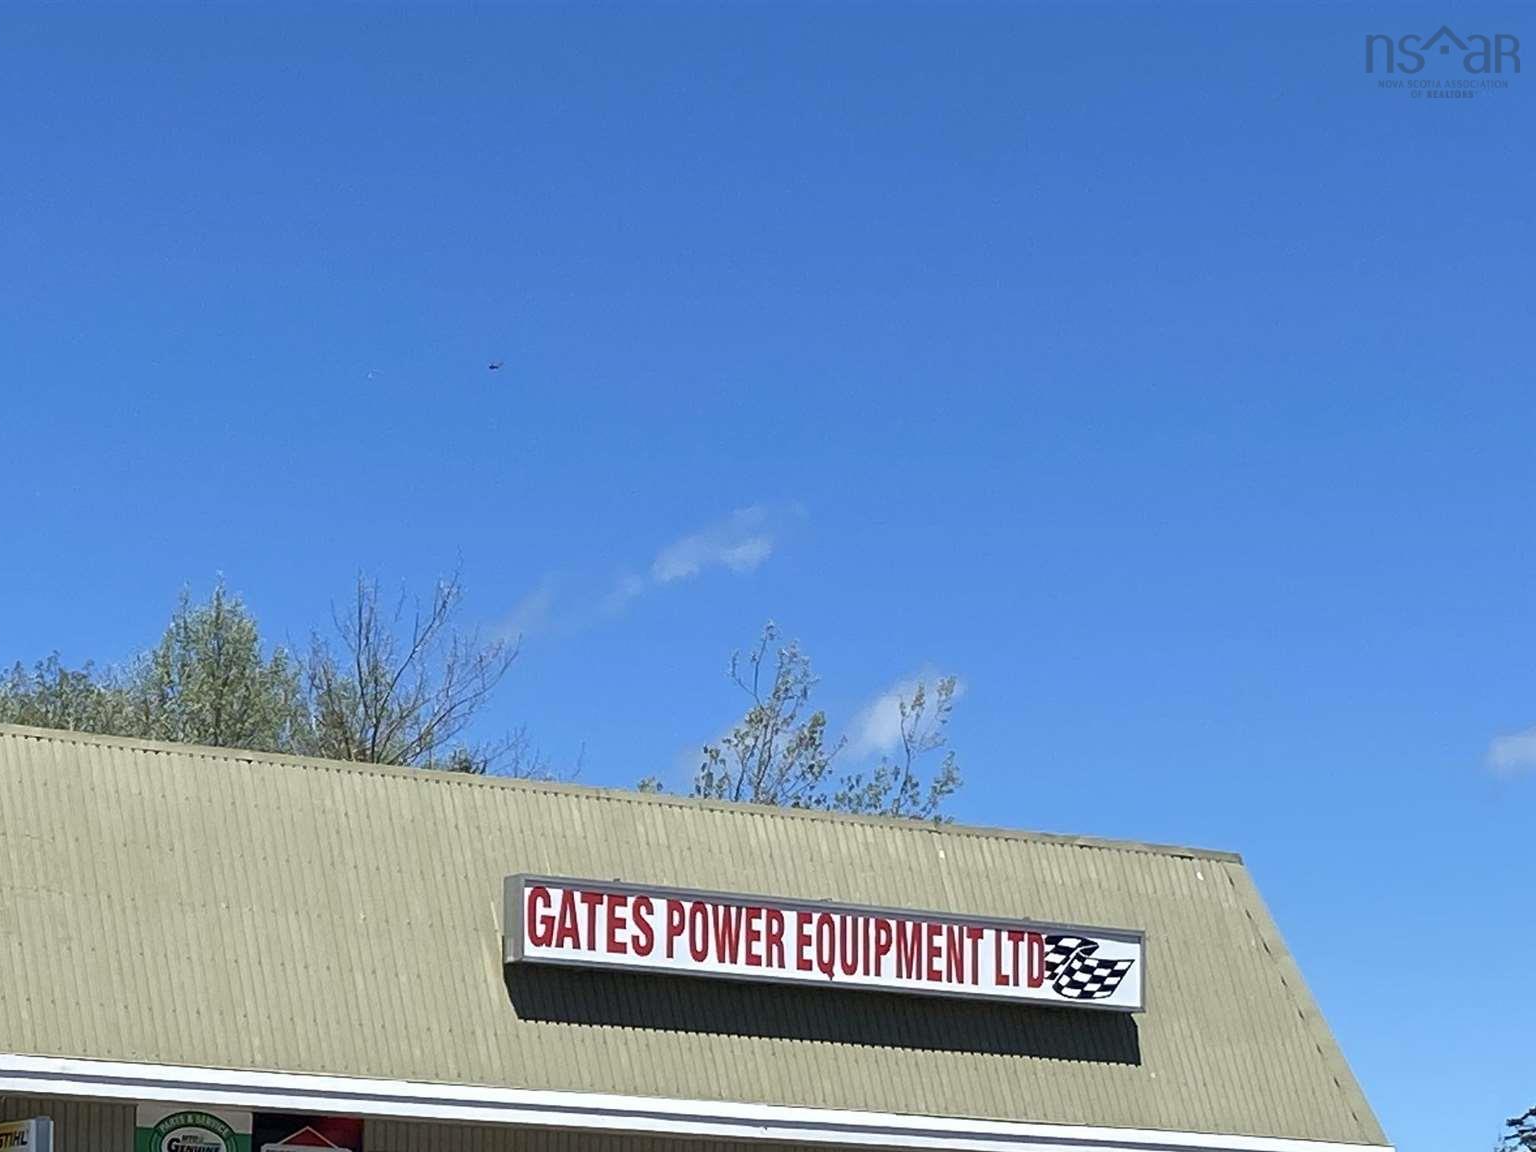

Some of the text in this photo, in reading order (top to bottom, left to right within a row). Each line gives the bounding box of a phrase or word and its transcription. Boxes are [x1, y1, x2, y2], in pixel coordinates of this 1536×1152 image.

[526, 886, 1046, 990] GATES POWER EQUIPMENT LTD
